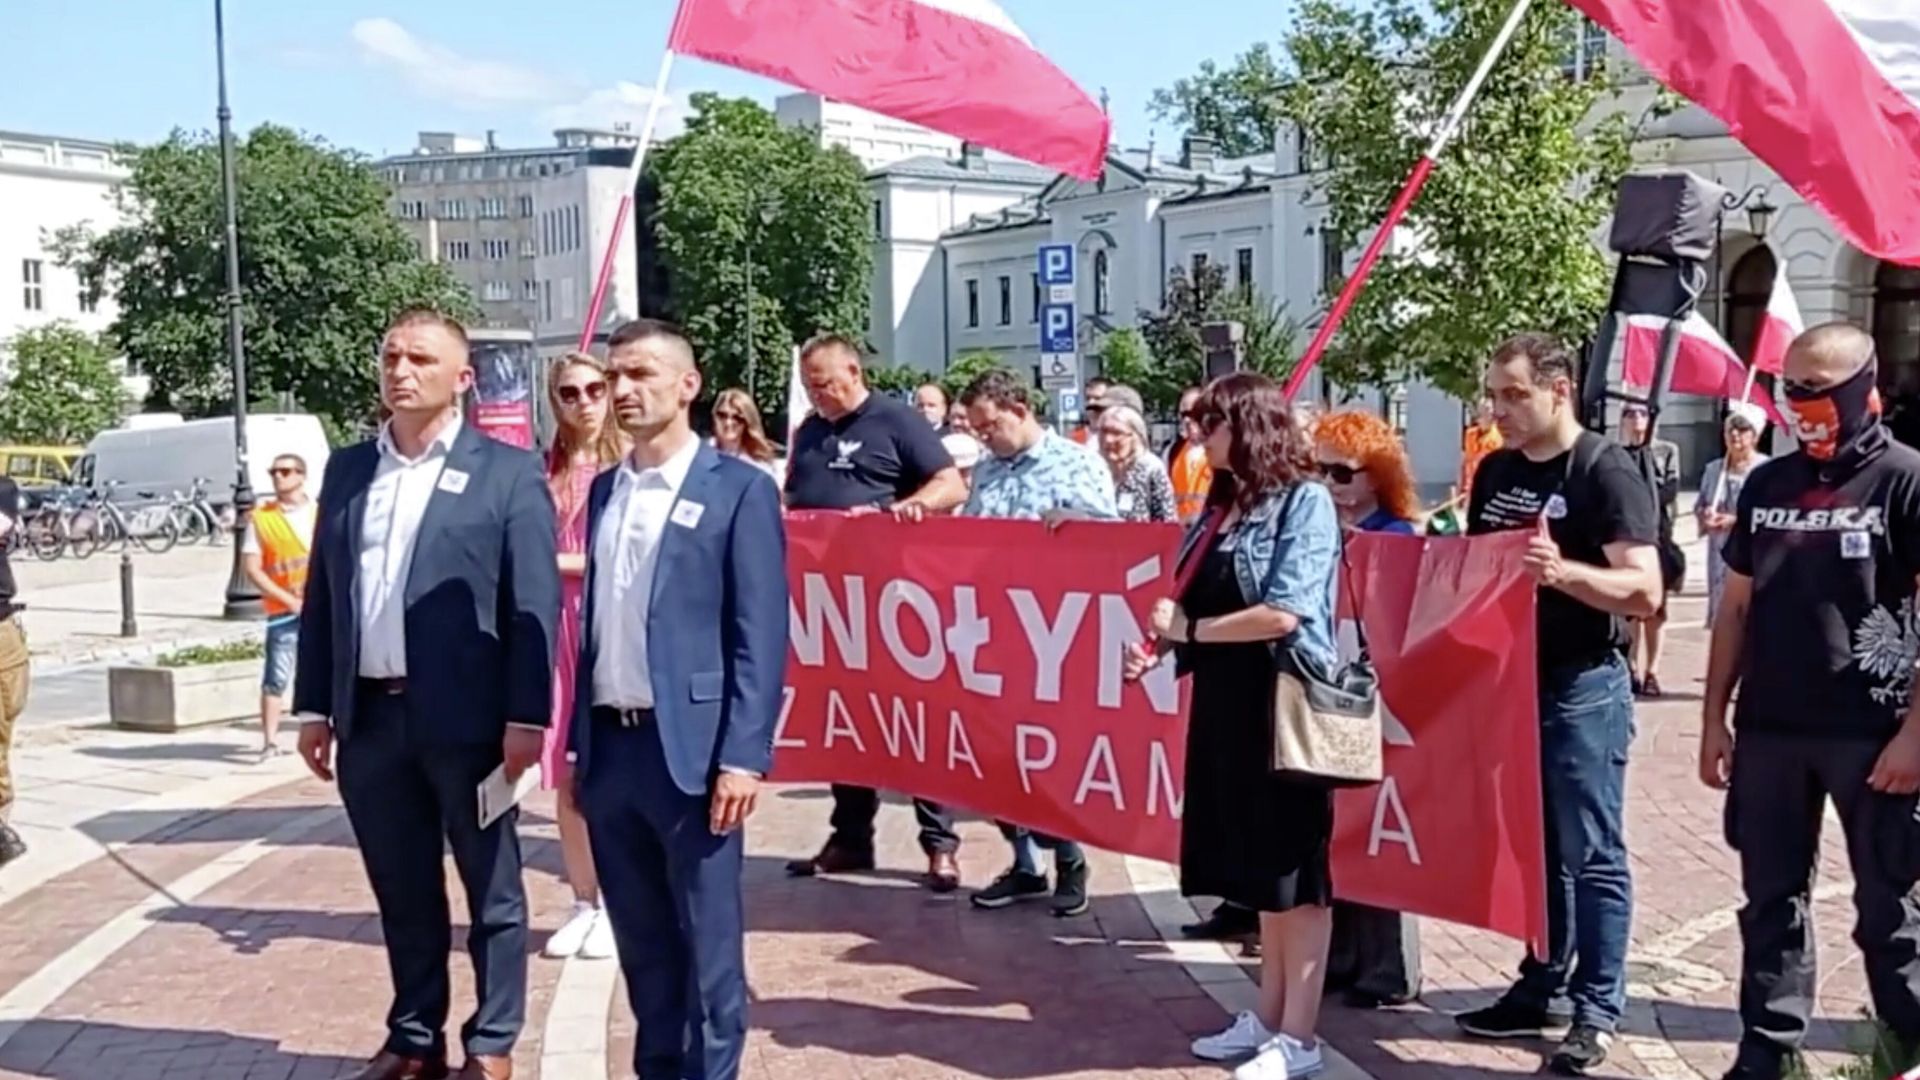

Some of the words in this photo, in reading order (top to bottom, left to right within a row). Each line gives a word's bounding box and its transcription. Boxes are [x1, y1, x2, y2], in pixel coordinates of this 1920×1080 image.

[1046, 249, 1067, 281] P
[1047, 308, 1068, 340] P
[1065, 396, 1076, 411] P
[1751, 505, 1884, 536] POLSKA
[788, 554, 1415, 746] WOŁYŃ
[772, 686, 984, 780] ZAWA
